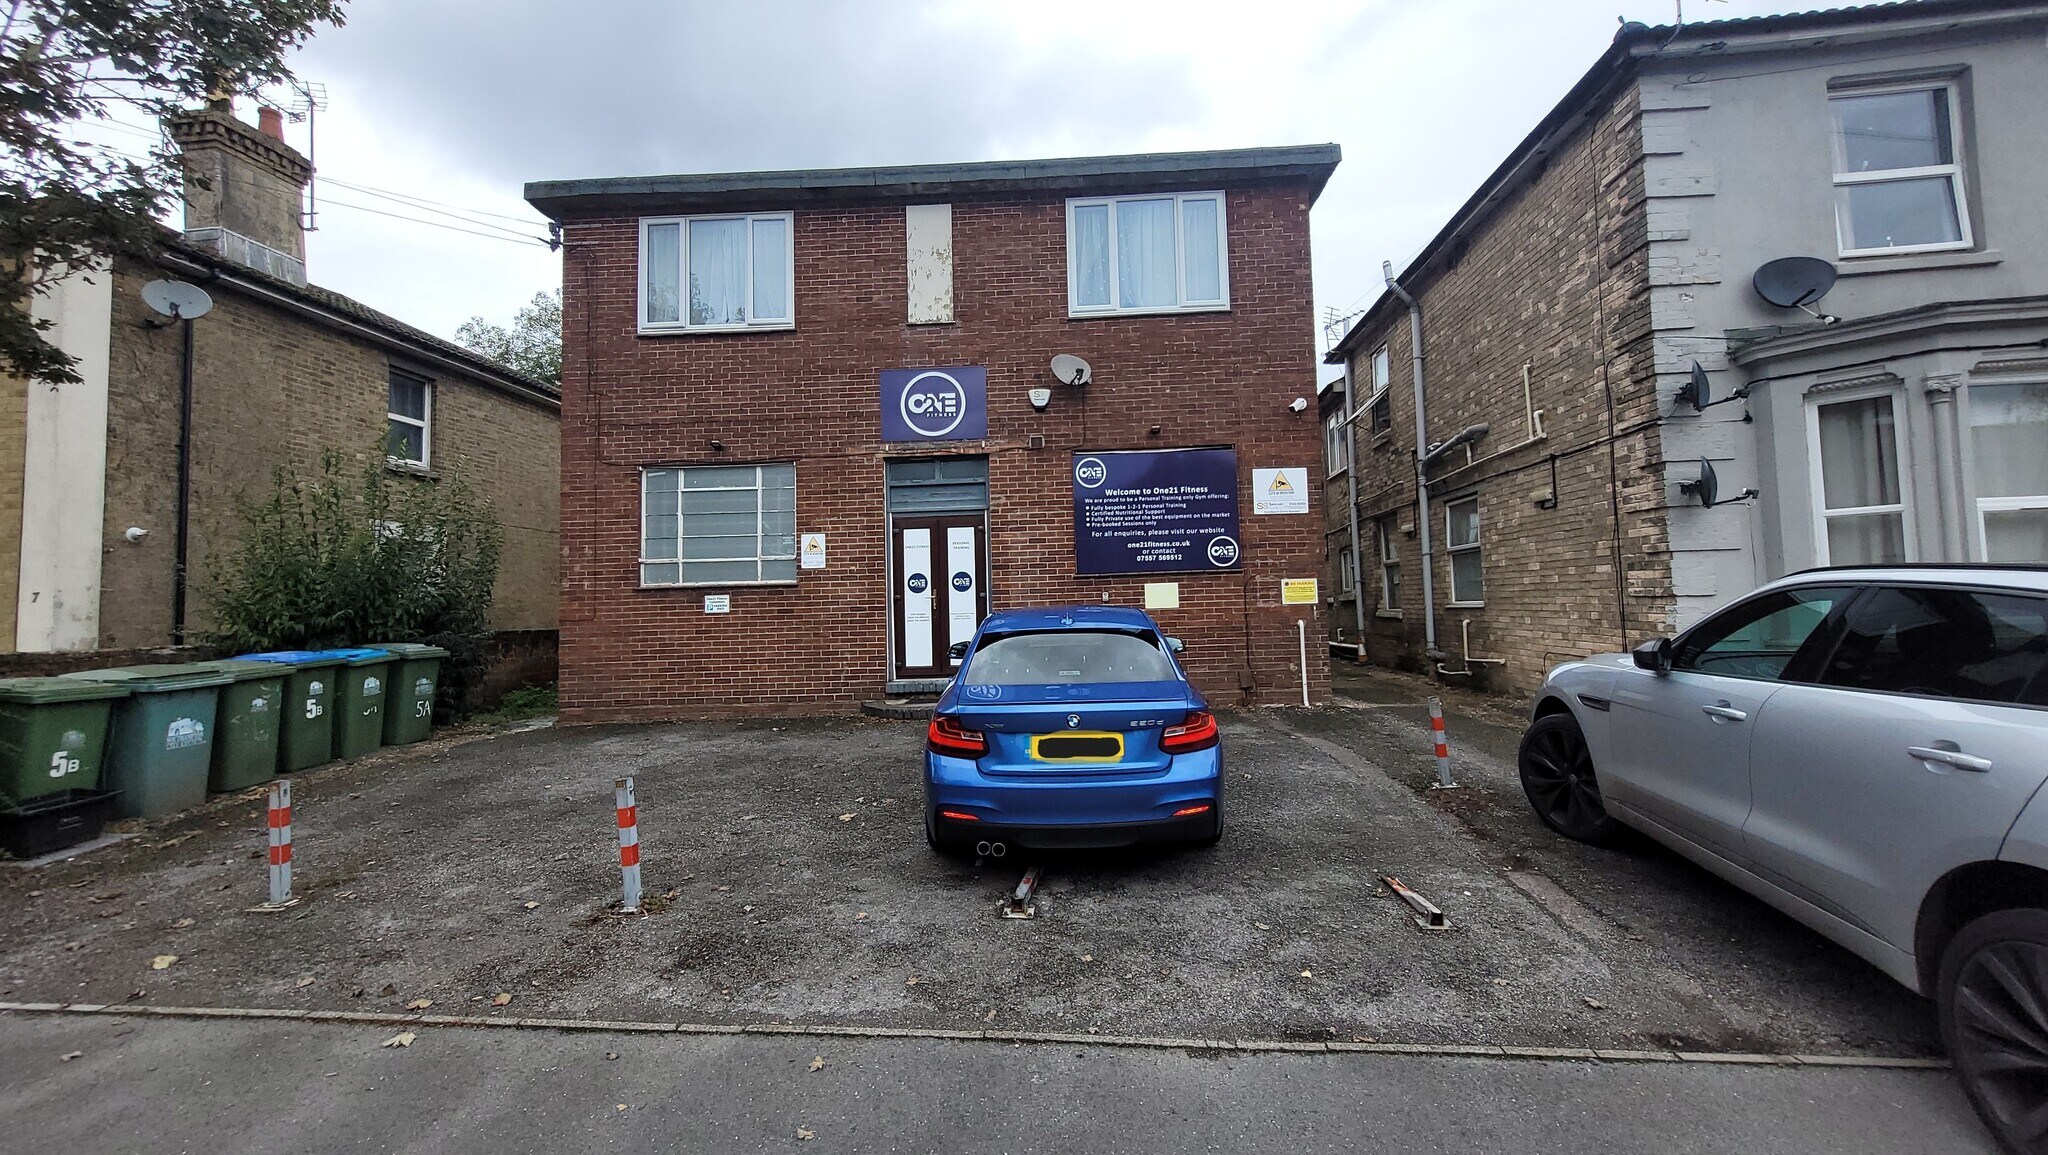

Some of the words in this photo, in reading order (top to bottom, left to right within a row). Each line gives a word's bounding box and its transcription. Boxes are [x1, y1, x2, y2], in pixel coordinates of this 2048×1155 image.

[1127, 540, 1190, 548] one21fitness.co.uk
[32, 592, 40, 603] 7
[306, 699, 323, 718] 5B
[416, 700, 431, 718] 5A
[50, 750, 80, 778] 5B
